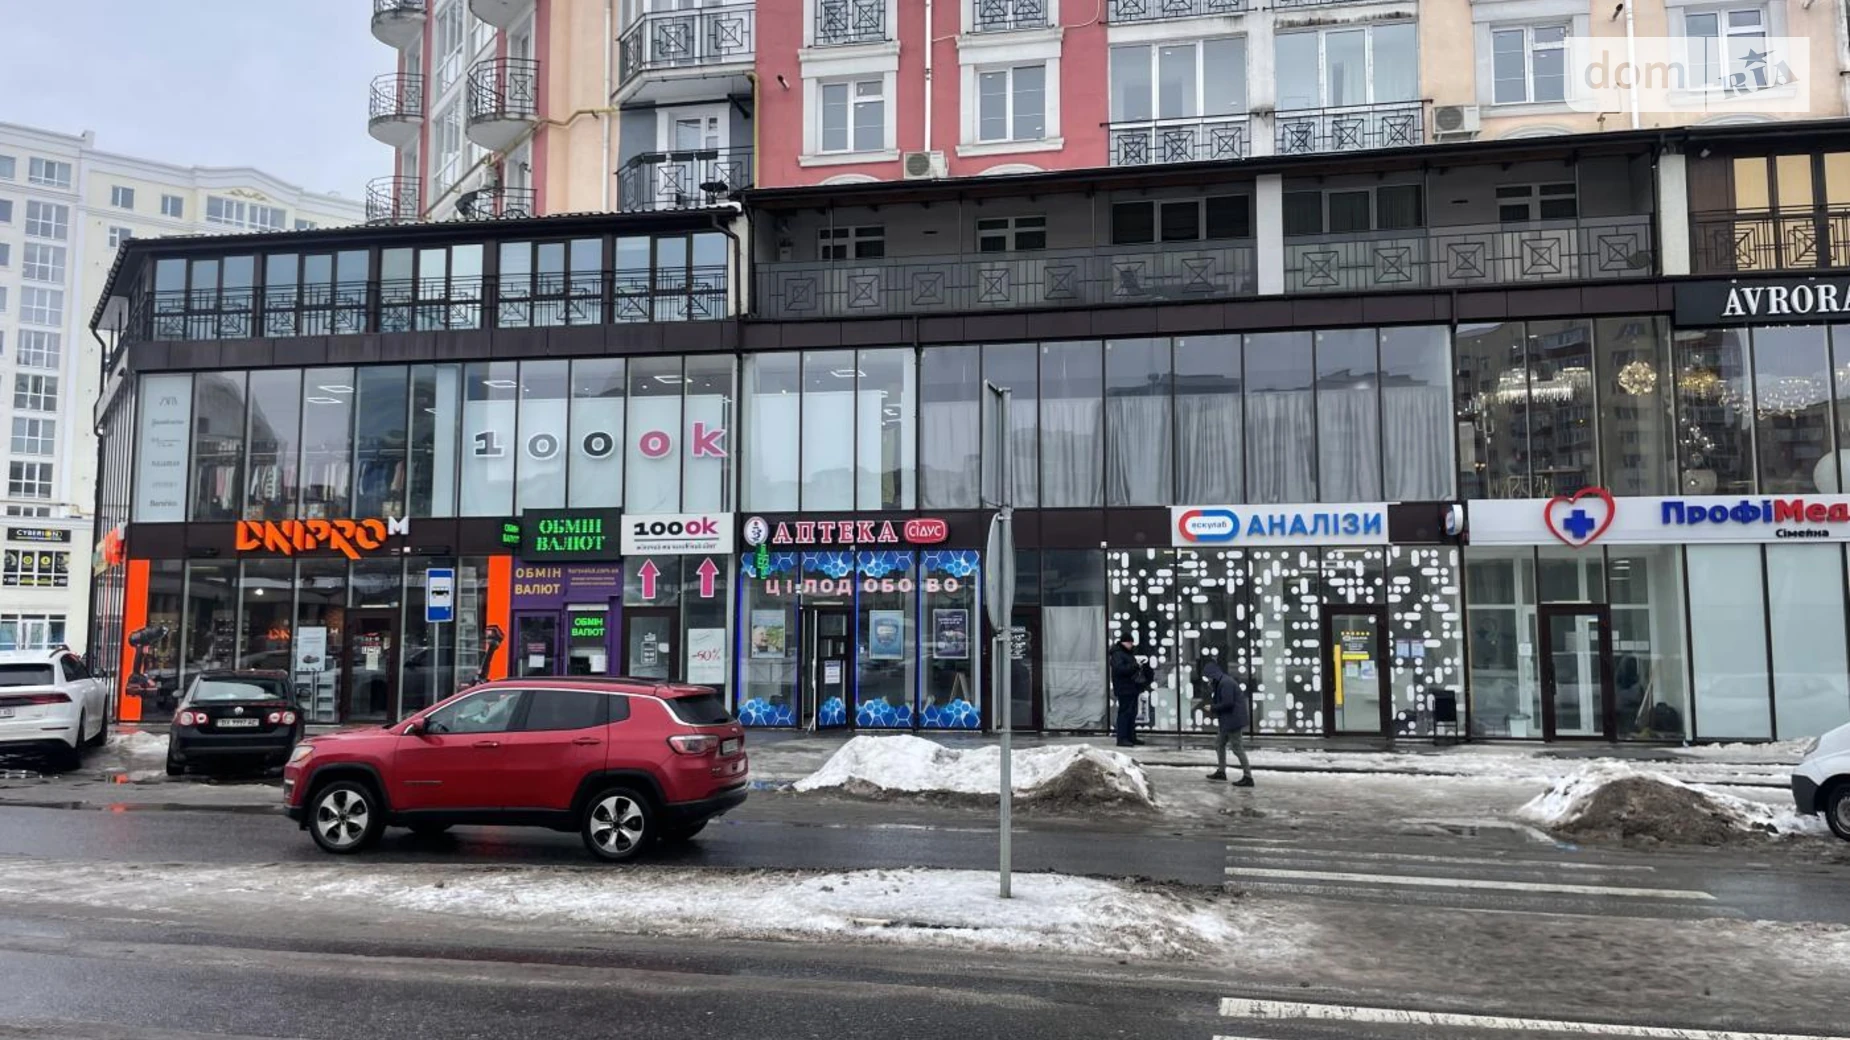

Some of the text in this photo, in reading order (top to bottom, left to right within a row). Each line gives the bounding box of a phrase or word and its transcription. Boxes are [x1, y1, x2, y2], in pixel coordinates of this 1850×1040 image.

[538, 518, 602, 534] ОБМІН
[772, 520, 898, 544] АПТЕКА
[1191, 513, 1383, 536] ескулаб АНАЛІЗИ
[236, 518, 387, 560] DNIPRO
[536, 535, 606, 551] ВАЛЮТ
[515, 567, 562, 578] ОБМІН
[514, 583, 561, 595] ВАЛЮТ
[574, 617, 604, 626] ОБМІН
[571, 627, 605, 636] ВАЛЮТ
